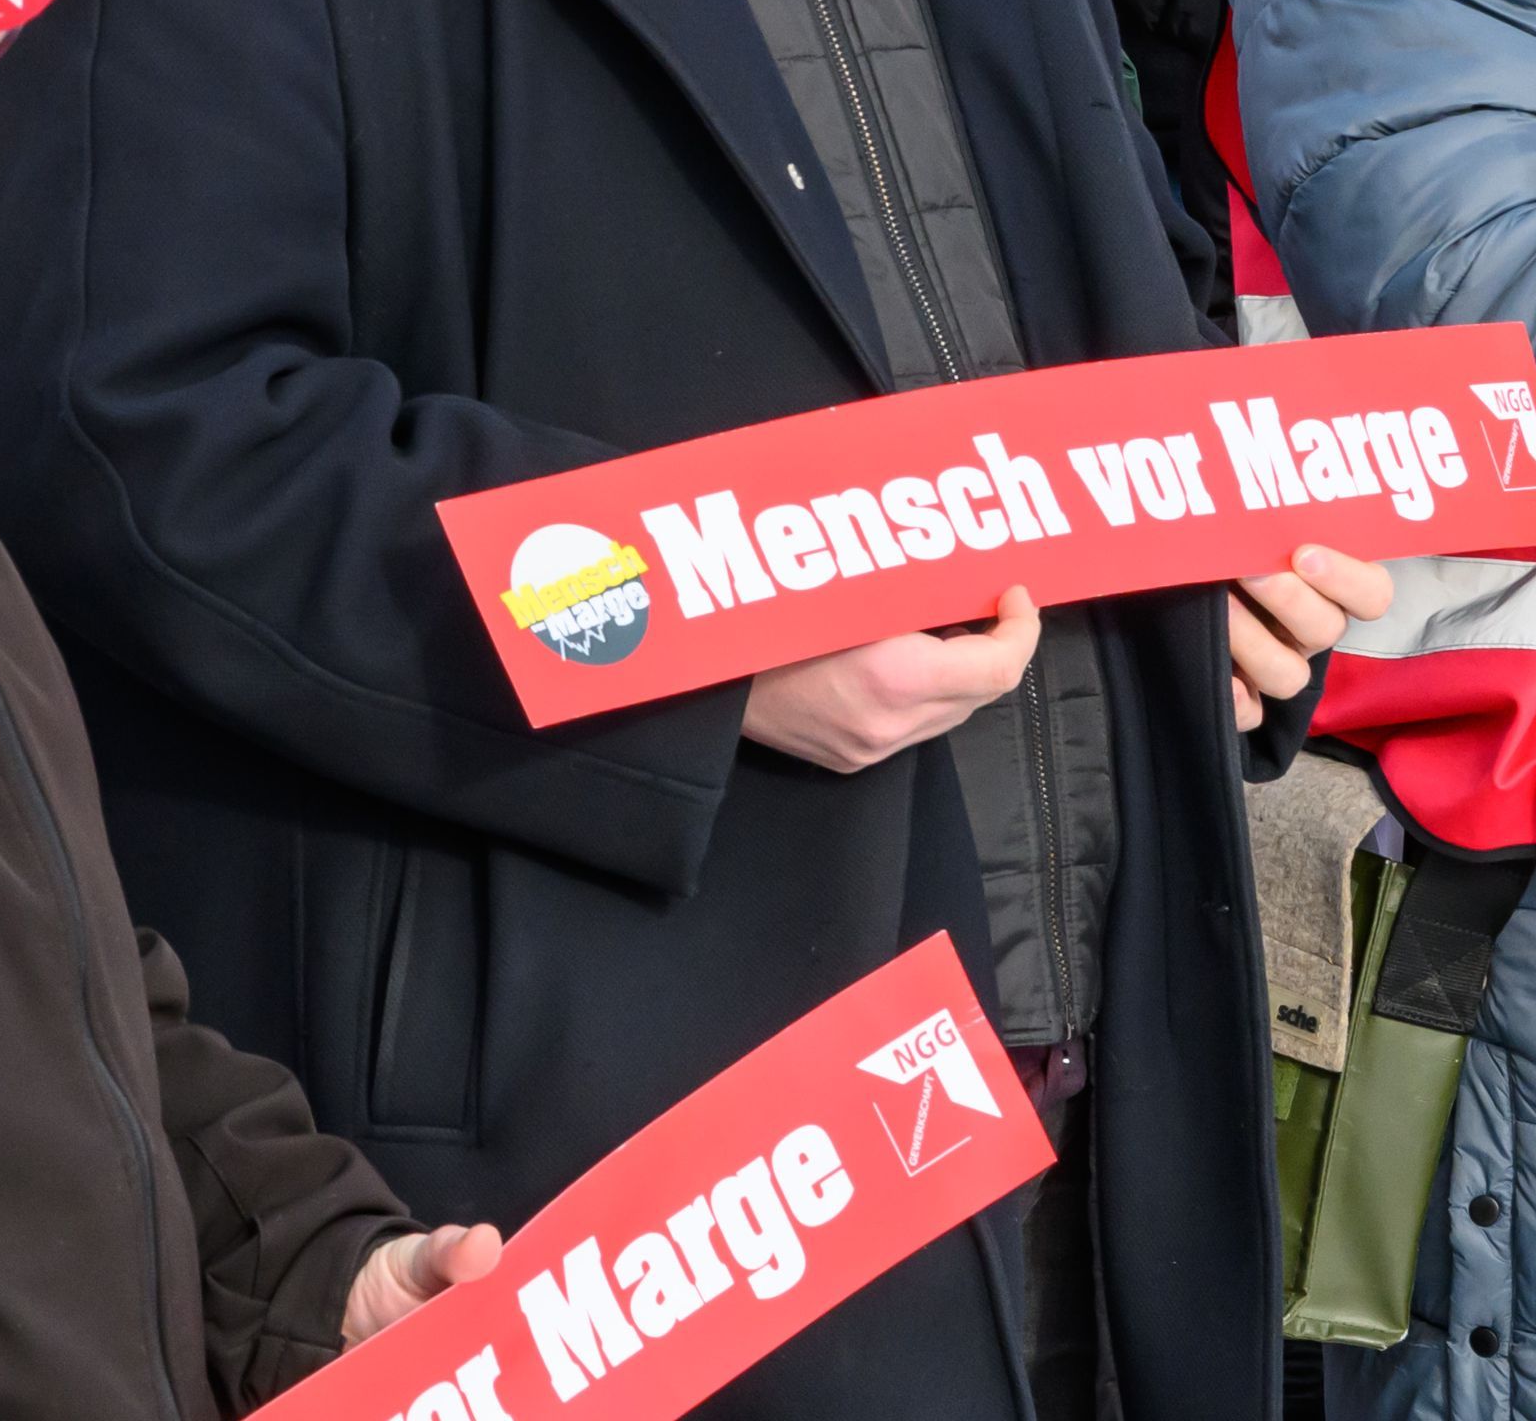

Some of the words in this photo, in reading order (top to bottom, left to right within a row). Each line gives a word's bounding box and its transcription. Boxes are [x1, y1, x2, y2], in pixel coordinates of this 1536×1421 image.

[1493, 387, 1533, 414] NGG
[640, 432, 1072, 619] Mensch
[1067, 432, 1216, 527] vor
[1209, 396, 1468, 521] Marge
[498, 539, 650, 630] Mensch
[543, 580, 651, 642] Marge
[892, 1018, 957, 1075] NGG
[908, 1073, 935, 1167] GEWERKSCHAFT
[517, 1124, 855, 1403] Marge
